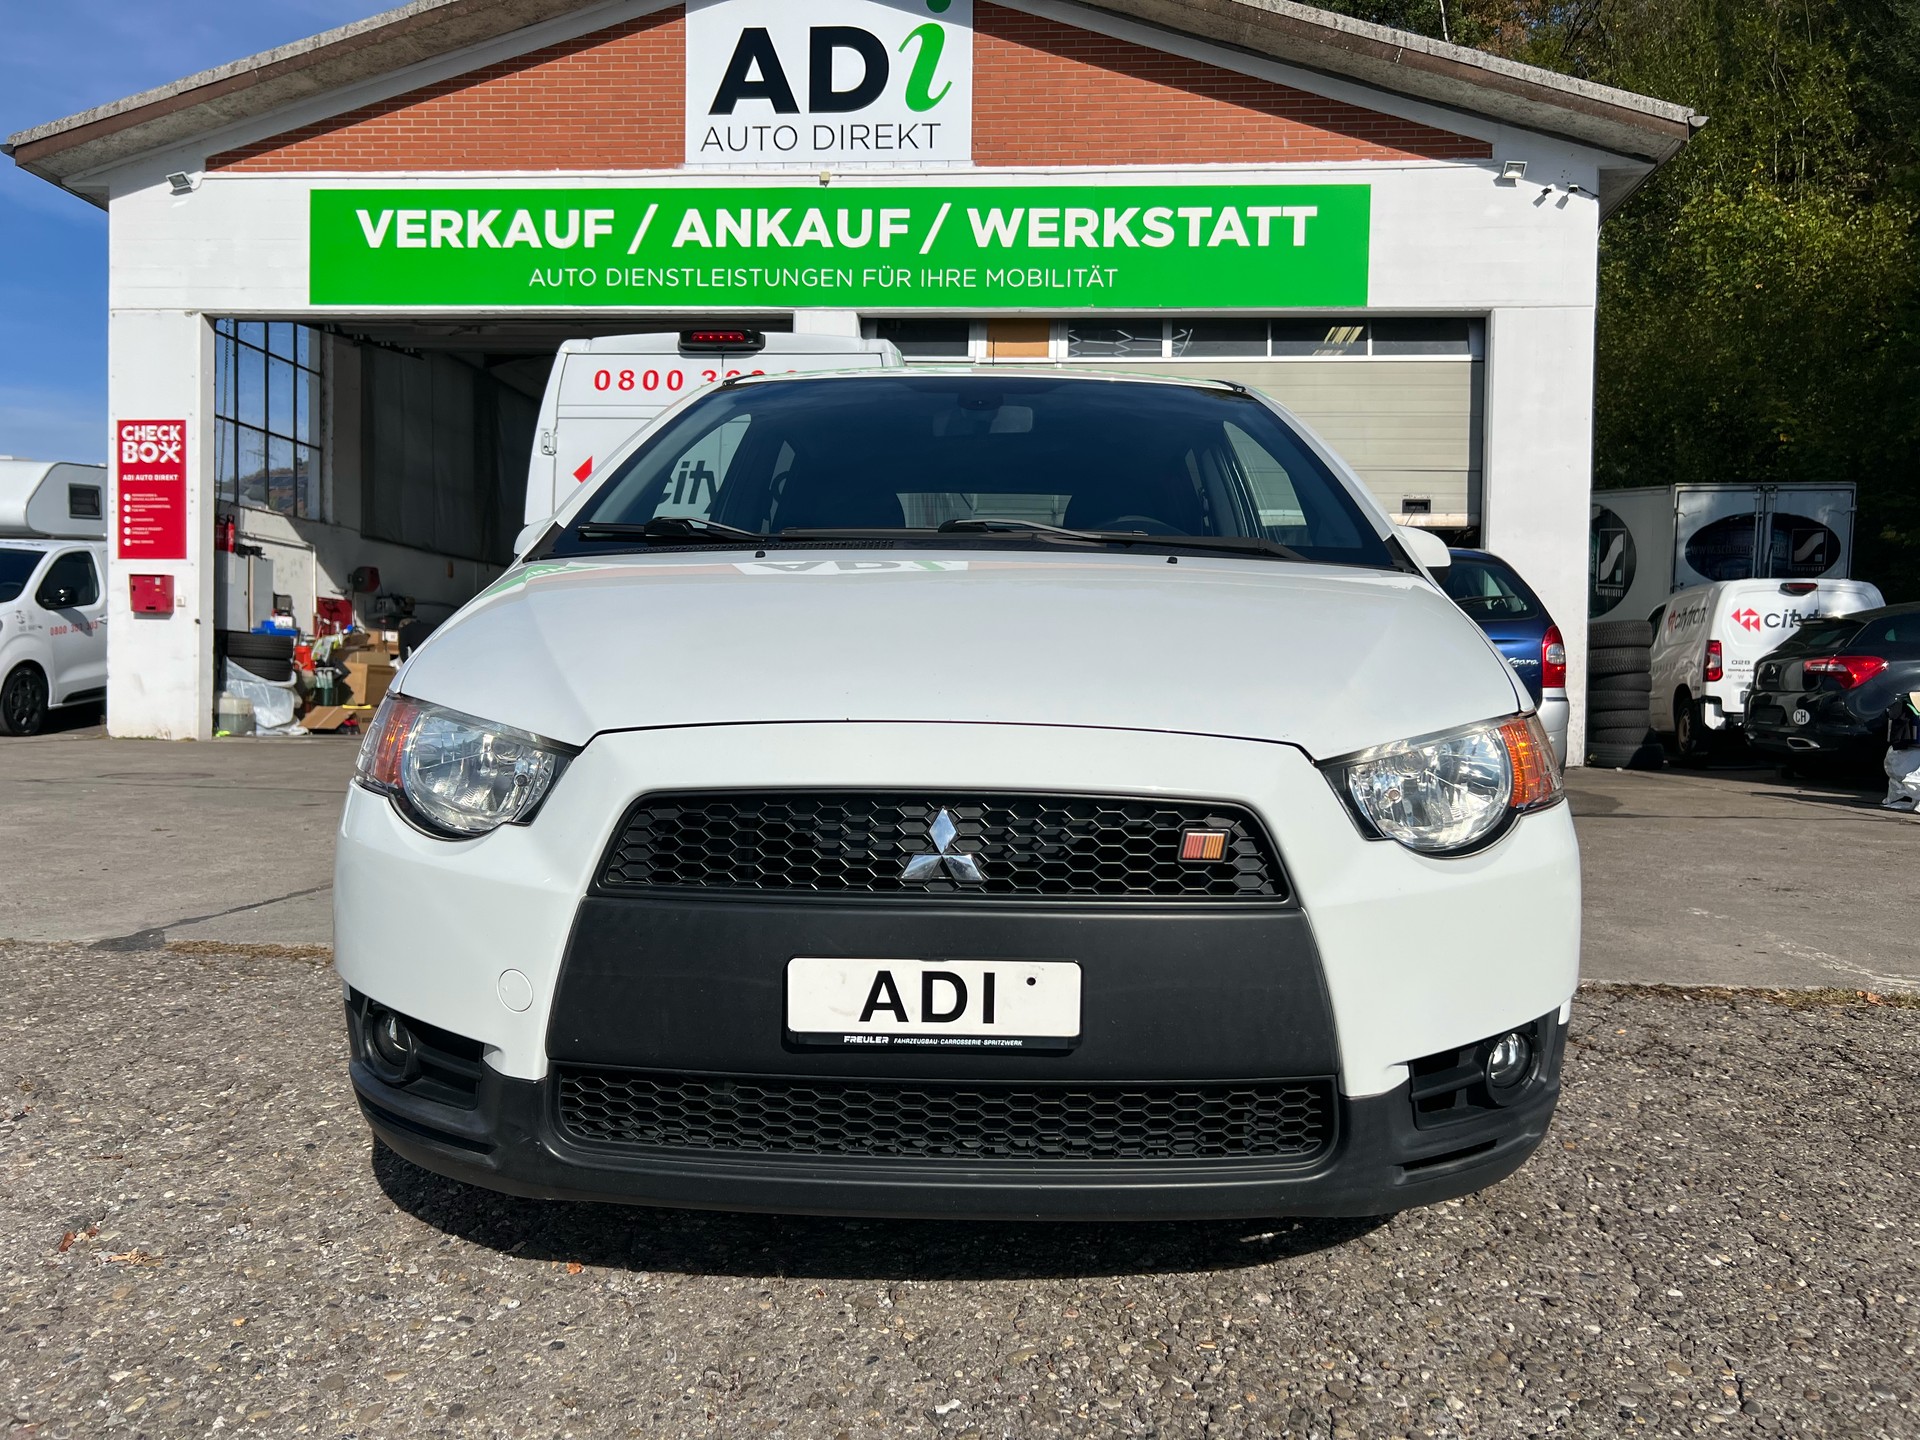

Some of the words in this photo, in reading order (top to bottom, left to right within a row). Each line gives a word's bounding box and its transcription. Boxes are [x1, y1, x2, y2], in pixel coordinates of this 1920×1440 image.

[701, 124, 798, 152] AUTO
[813, 122, 942, 151] DIREKT
[355, 208, 615, 249] VERKAUF
[671, 207, 911, 249] ANKAUF
[966, 205, 1318, 248] WERKSTATT
[529, 267, 597, 287] AUTO
[606, 267, 853, 288] DIENSTLEISTUNGEN
[863, 265, 911, 288] FÜR
[921, 267, 977, 288] IHRE
[986, 265, 1118, 288] MOBILITÄT
[594, 369, 684, 391] 0800
[121, 425, 181, 441] CHECK
[122, 441, 181, 463] BOX
[1795, 711, 1807, 723] CH
[858, 970, 996, 1024] ADI
[843, 1035, 890, 1044] FREULER
